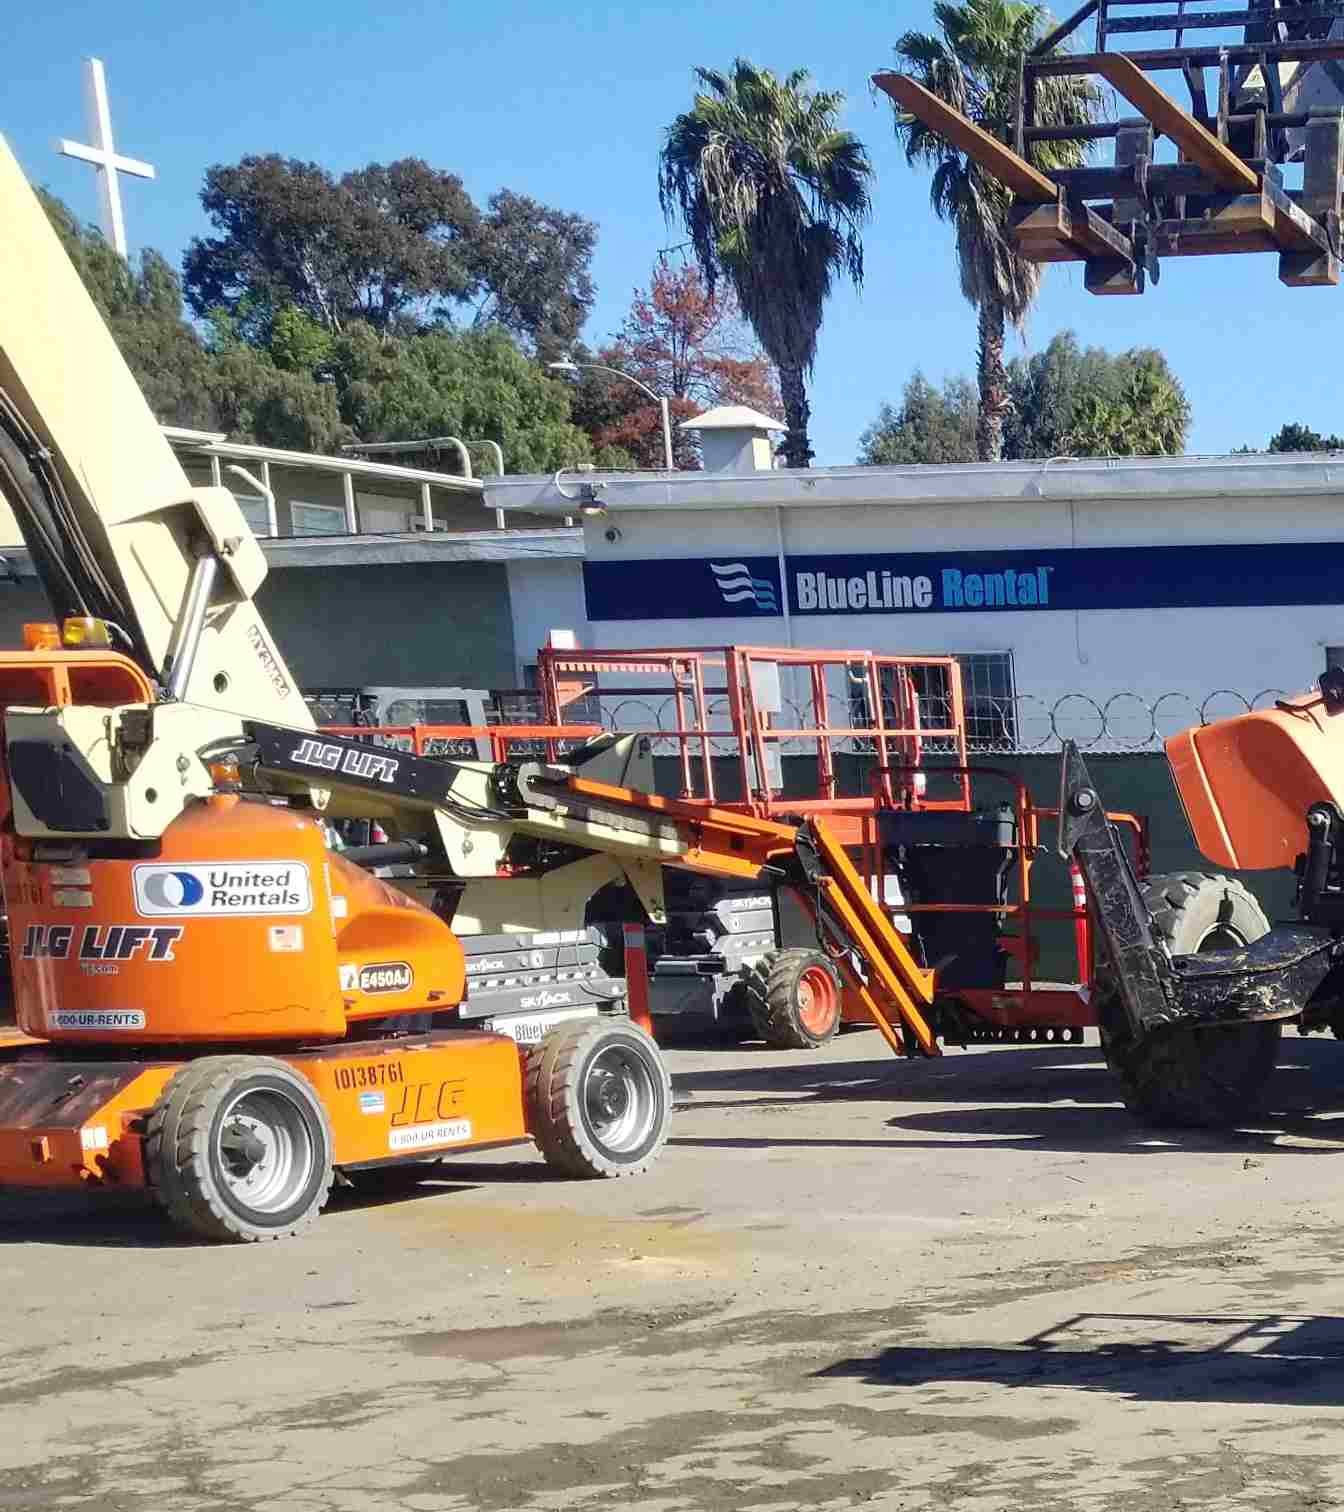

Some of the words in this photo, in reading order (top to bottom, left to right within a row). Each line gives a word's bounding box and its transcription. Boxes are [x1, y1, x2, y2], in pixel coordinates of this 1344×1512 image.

[796, 571, 933, 609] BlueLine
[942, 567, 1049, 606] Rental
[291, 740, 343, 771] JLG
[341, 750, 399, 783] LIFT
[209, 870, 290, 888] United
[211, 889, 300, 907] Rentals
[79, 926, 185, 960] LIFT
[361, 968, 410, 989] E450AJ
[334, 1062, 404, 1091] 10138761
[391, 1077, 468, 1127] JLG
